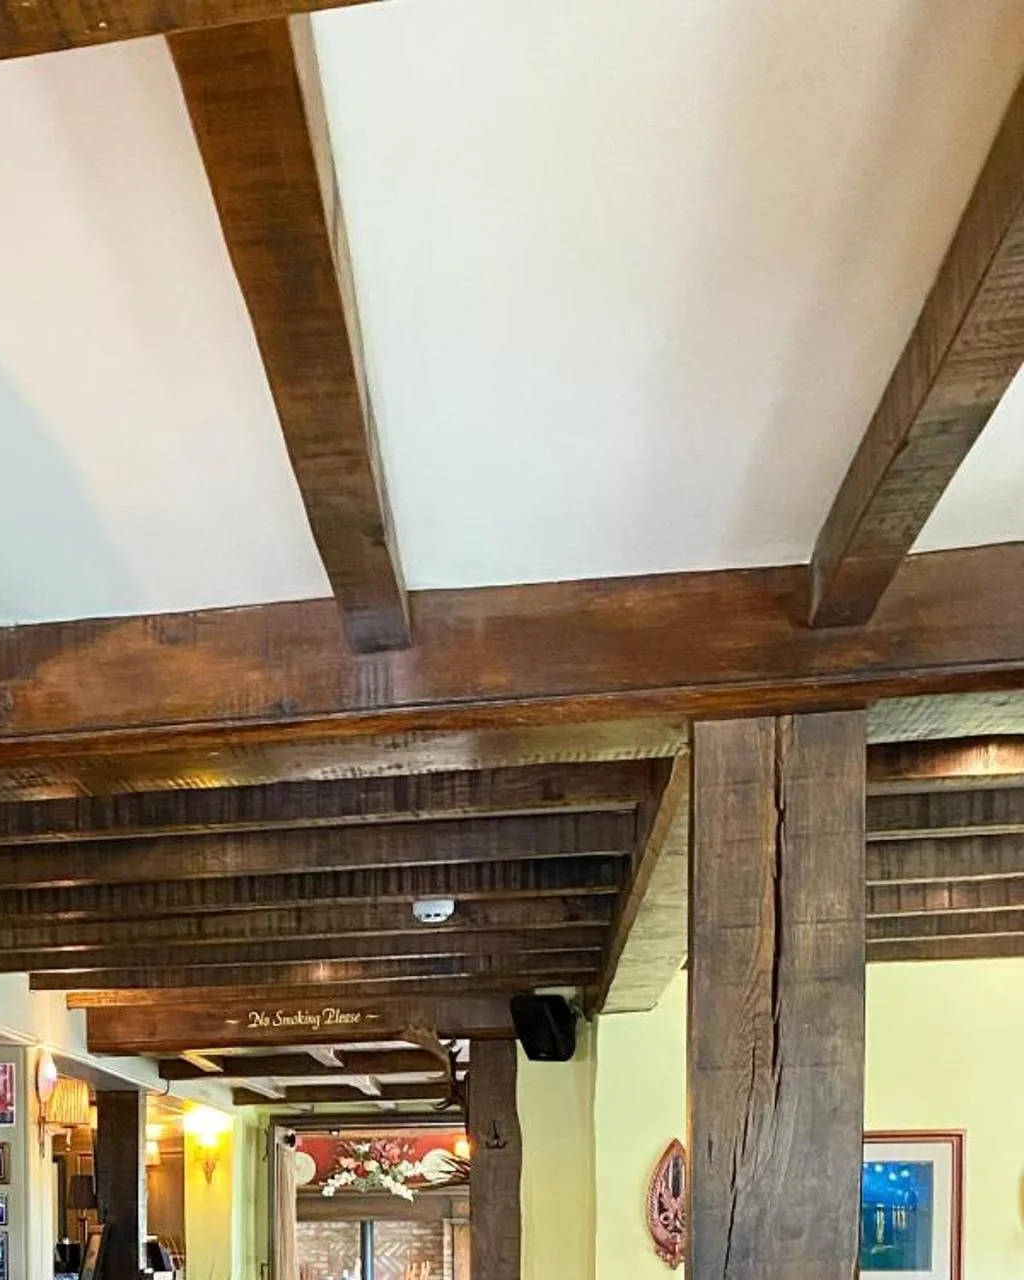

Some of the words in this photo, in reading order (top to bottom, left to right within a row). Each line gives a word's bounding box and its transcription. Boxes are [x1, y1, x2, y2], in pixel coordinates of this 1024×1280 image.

[247, 1011, 270, 1029] No
[272, 1010, 321, 1030] Smoking
[321, 1007, 362, 1026] Please
